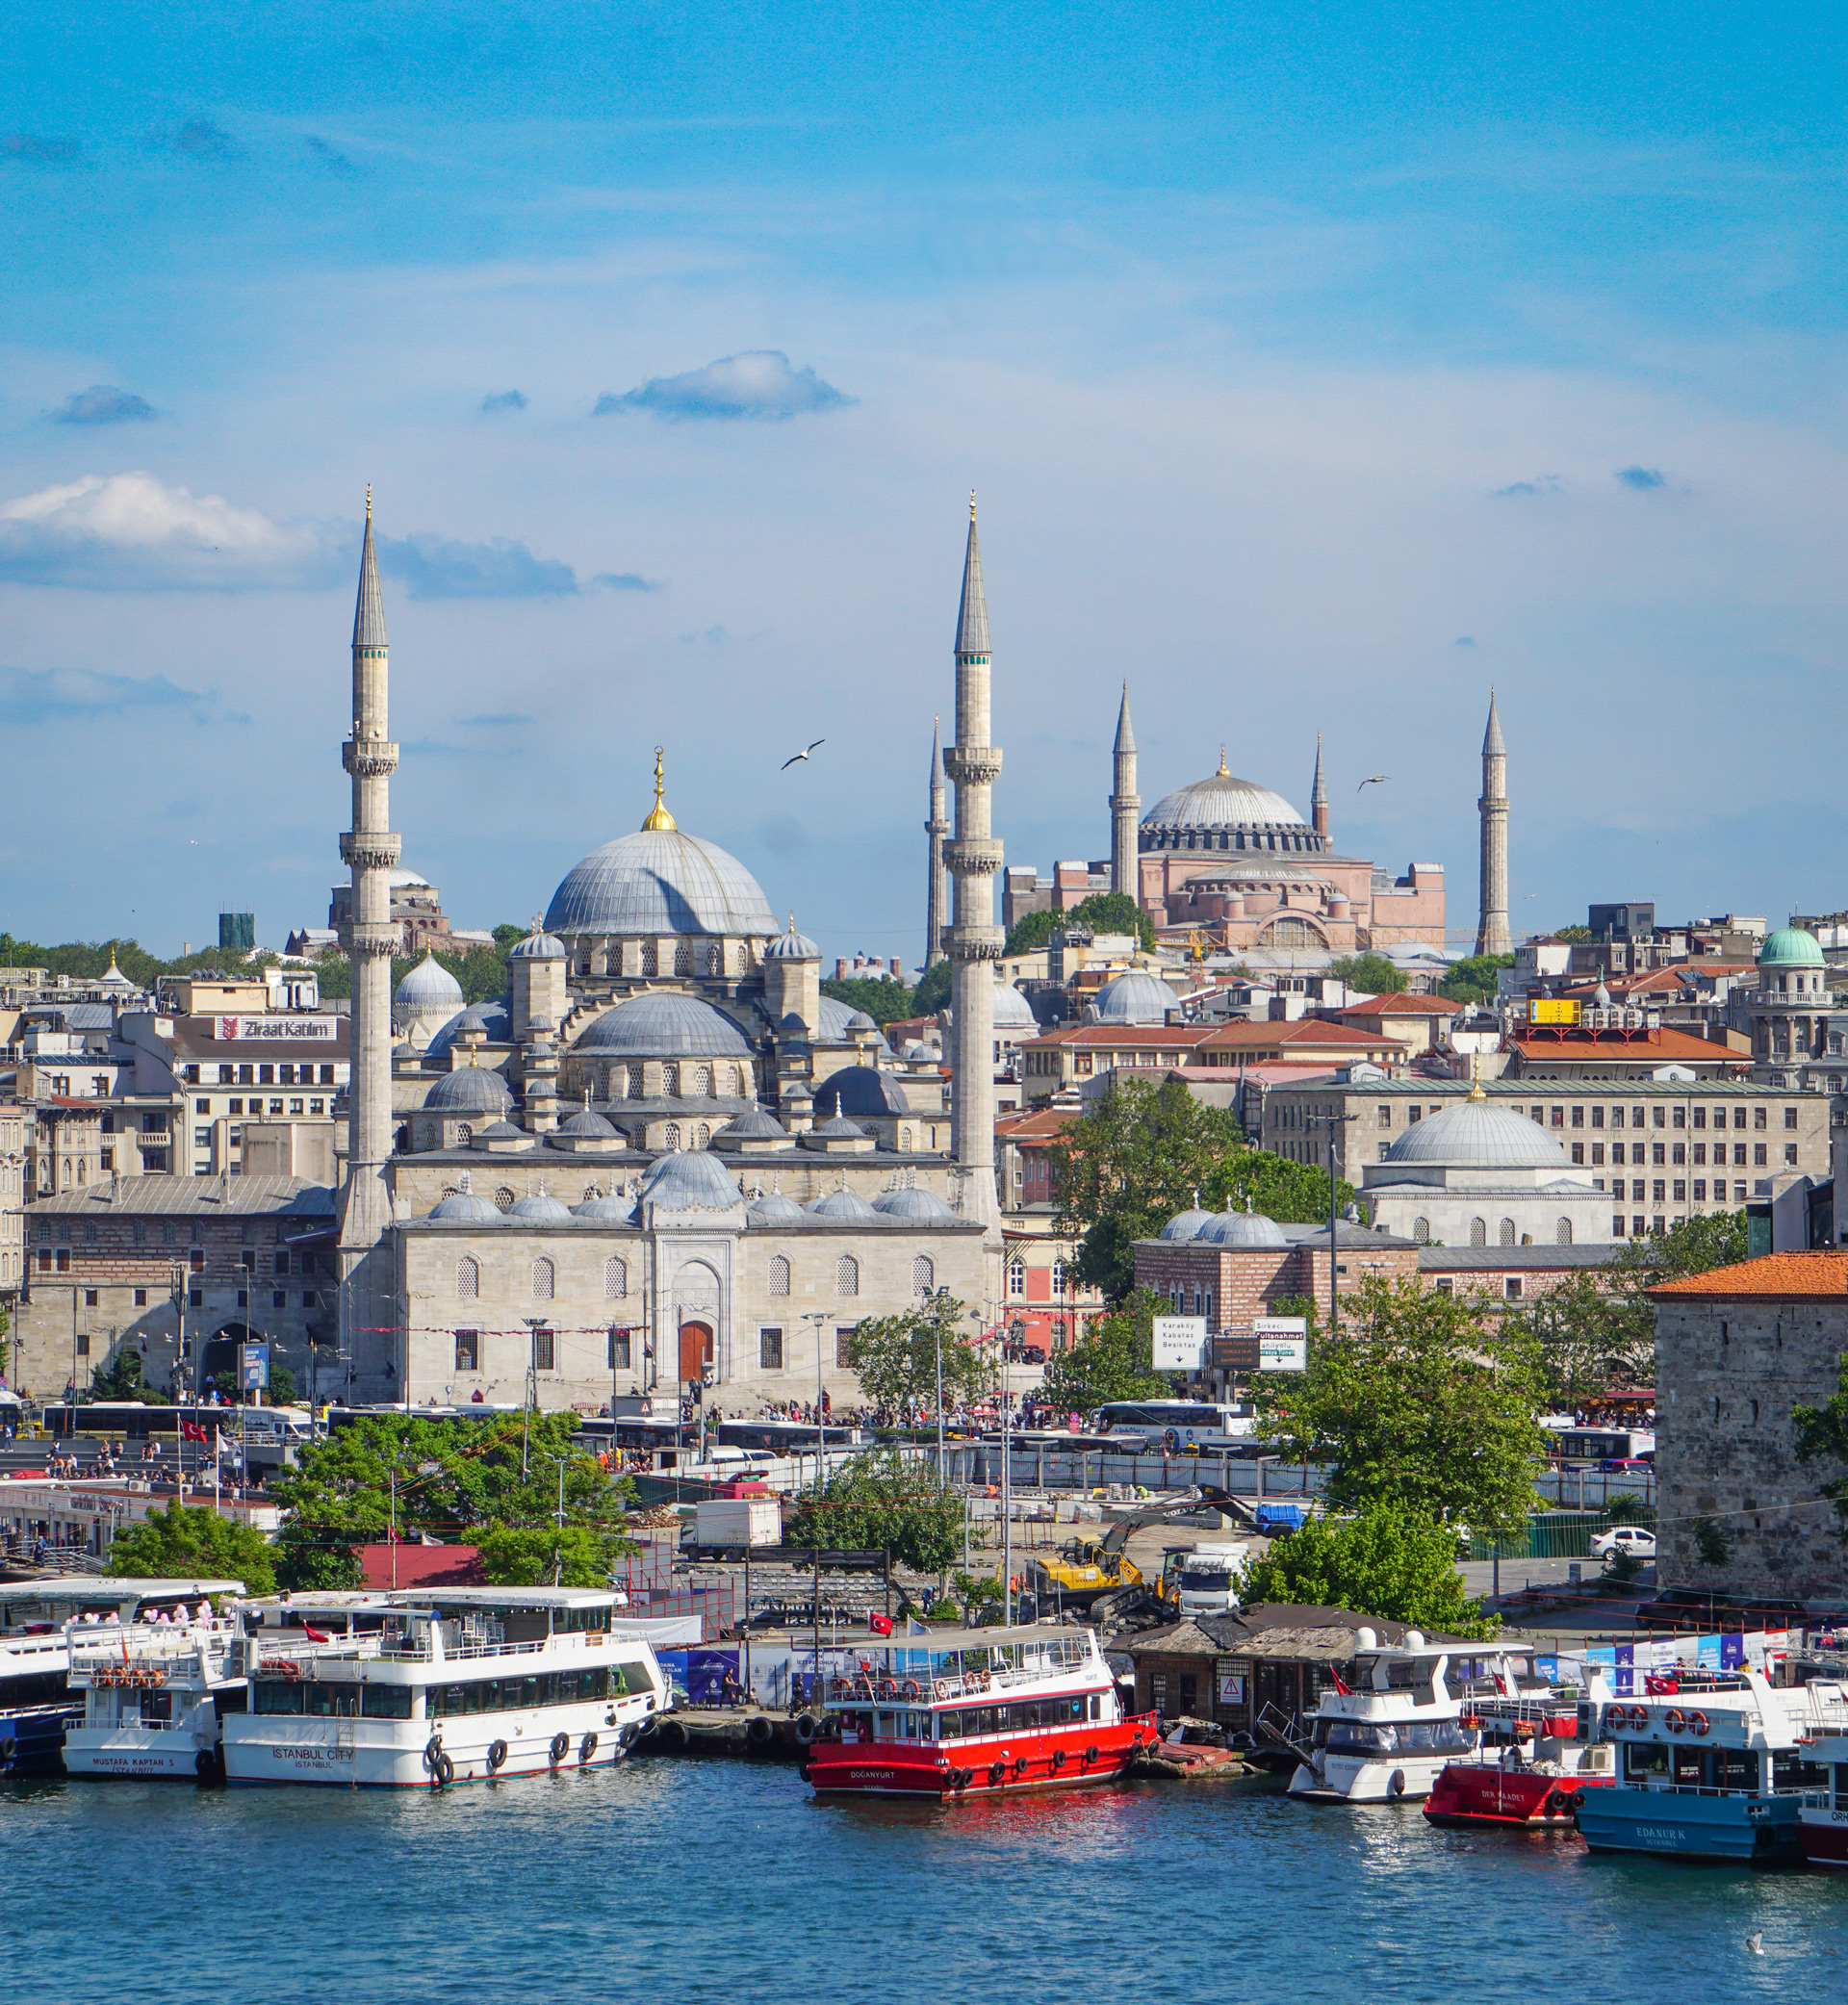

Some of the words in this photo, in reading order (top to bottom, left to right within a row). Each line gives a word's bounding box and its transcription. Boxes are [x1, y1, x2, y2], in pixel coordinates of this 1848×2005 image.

[244, 1021, 283, 1037] Ziraat
[286, 1021, 328, 1037] Katılım
[1163, 1322, 1194, 1330] Karaköy
[1162, 1505, 1196, 1518] VOLVO
[1122, 1564, 1136, 1581] JCB
[272, 1747, 324, 1760] İSTANBUL
[850, 1770, 895, 1779] DOĞANYURT
[1636, 1827, 1677, 1839] EDANUR
[1678, 1829, 1686, 1839] K
